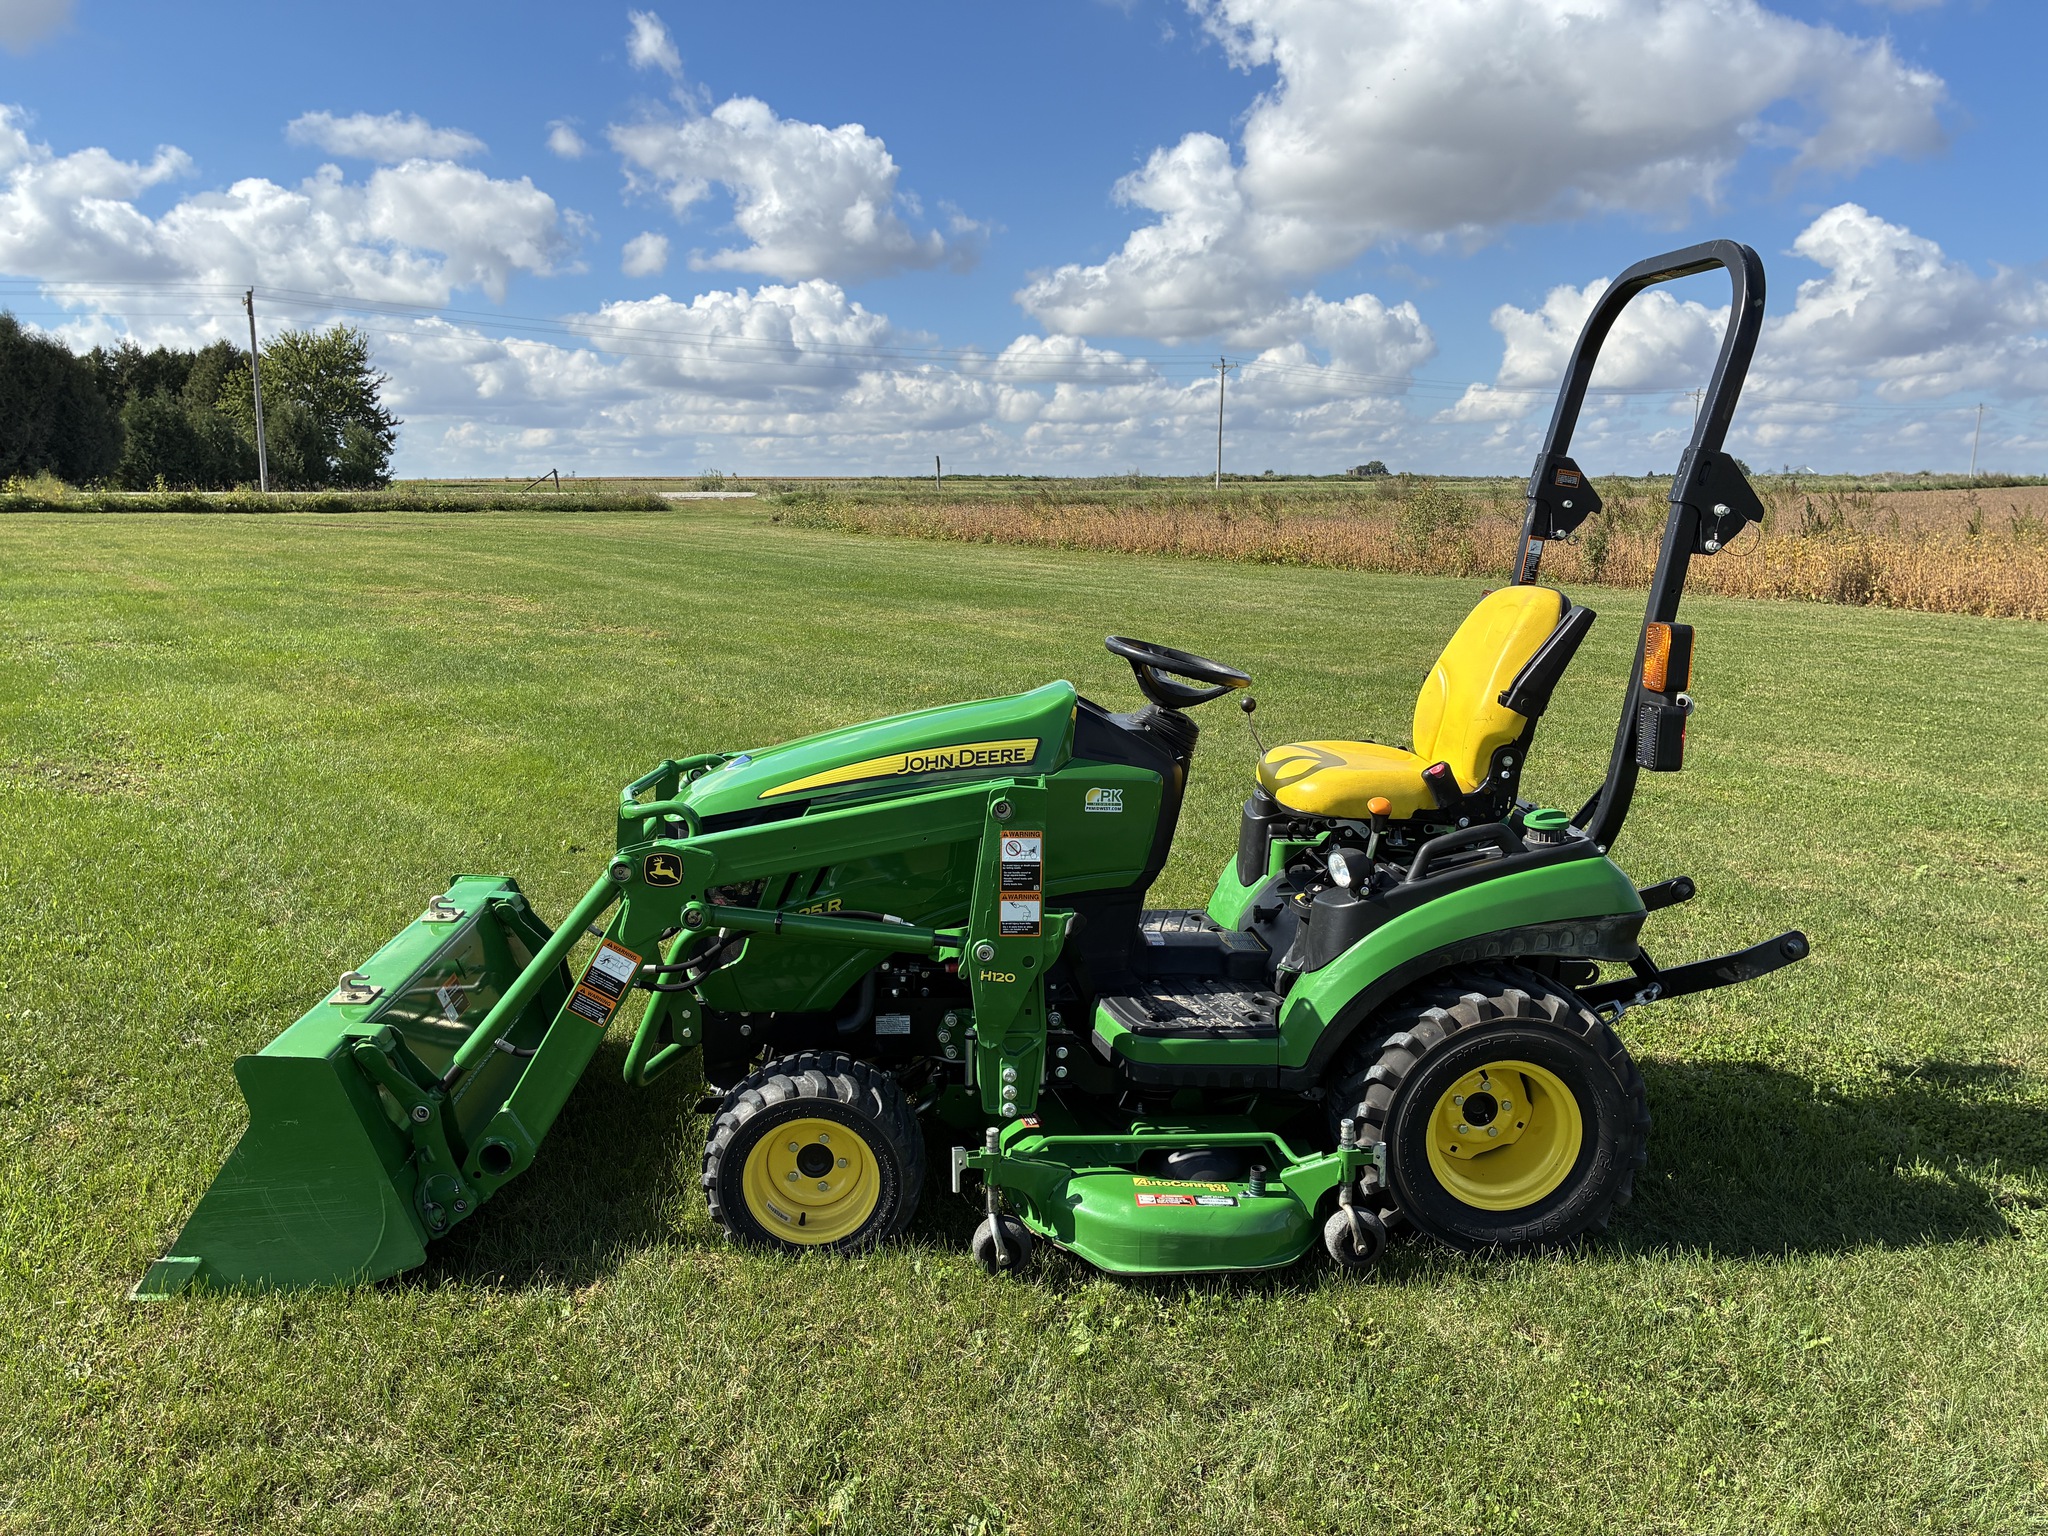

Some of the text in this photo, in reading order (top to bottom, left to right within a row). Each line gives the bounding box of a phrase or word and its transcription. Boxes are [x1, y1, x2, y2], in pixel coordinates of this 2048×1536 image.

[897, 748, 1026, 773] JOHN DEERE
[1100, 789, 1122, 802] PK
[613, 944, 637, 961] WARNING
[980, 970, 1016, 983] H120
[587, 990, 612, 1007] WARNING
